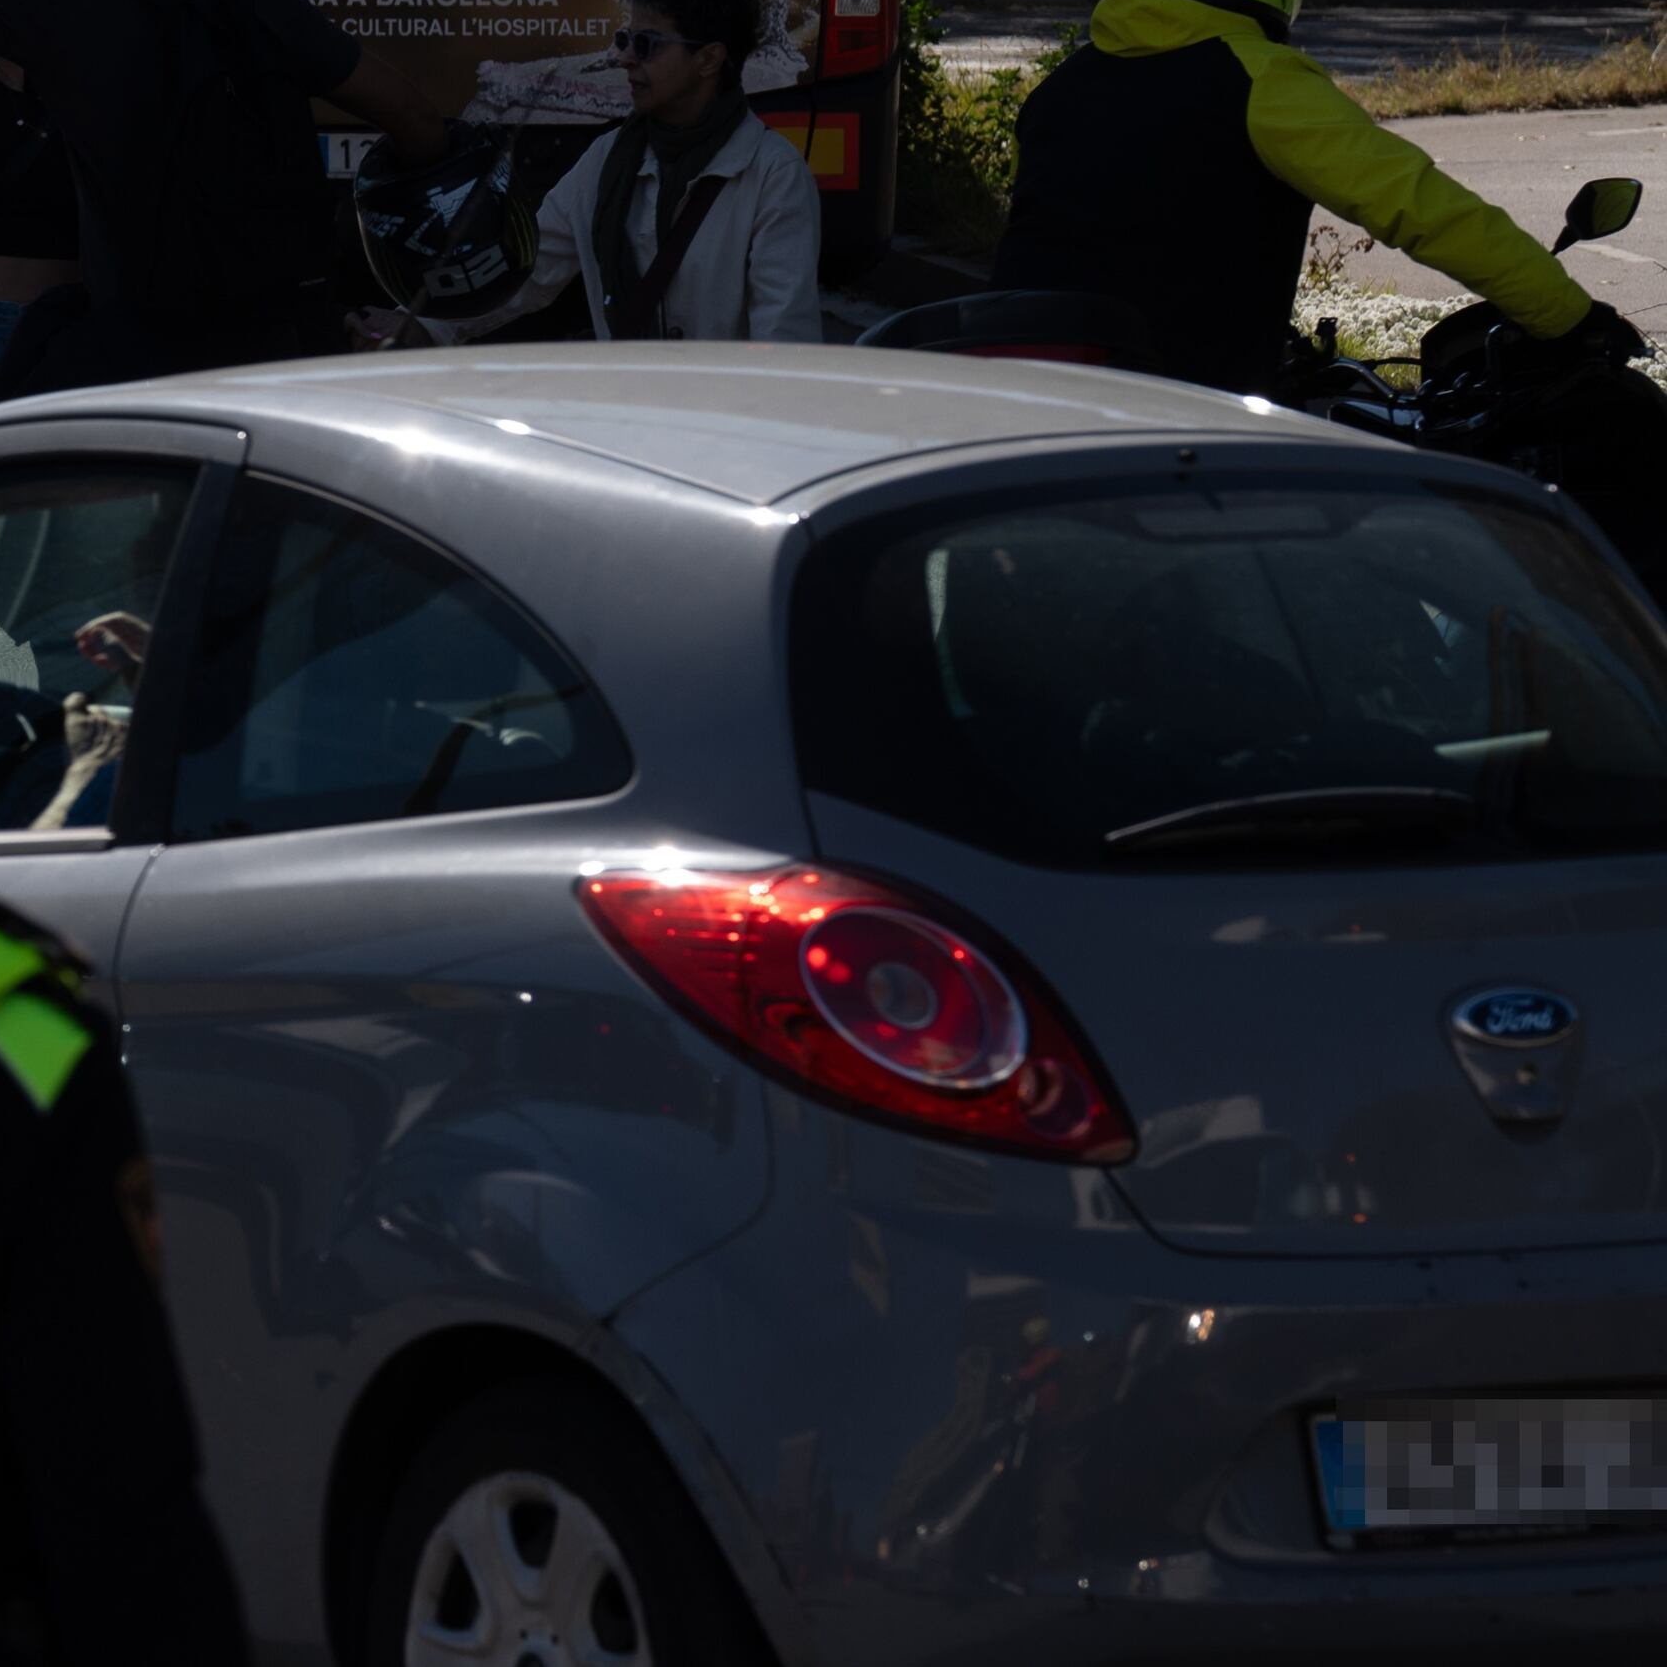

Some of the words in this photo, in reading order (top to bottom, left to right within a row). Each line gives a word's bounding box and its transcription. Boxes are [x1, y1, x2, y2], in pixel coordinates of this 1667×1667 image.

[341, 17, 455, 36] CULTURAL
[461, 16, 610, 36] L'HOSPITALET
[1484, 1001, 1556, 1035] Ford
